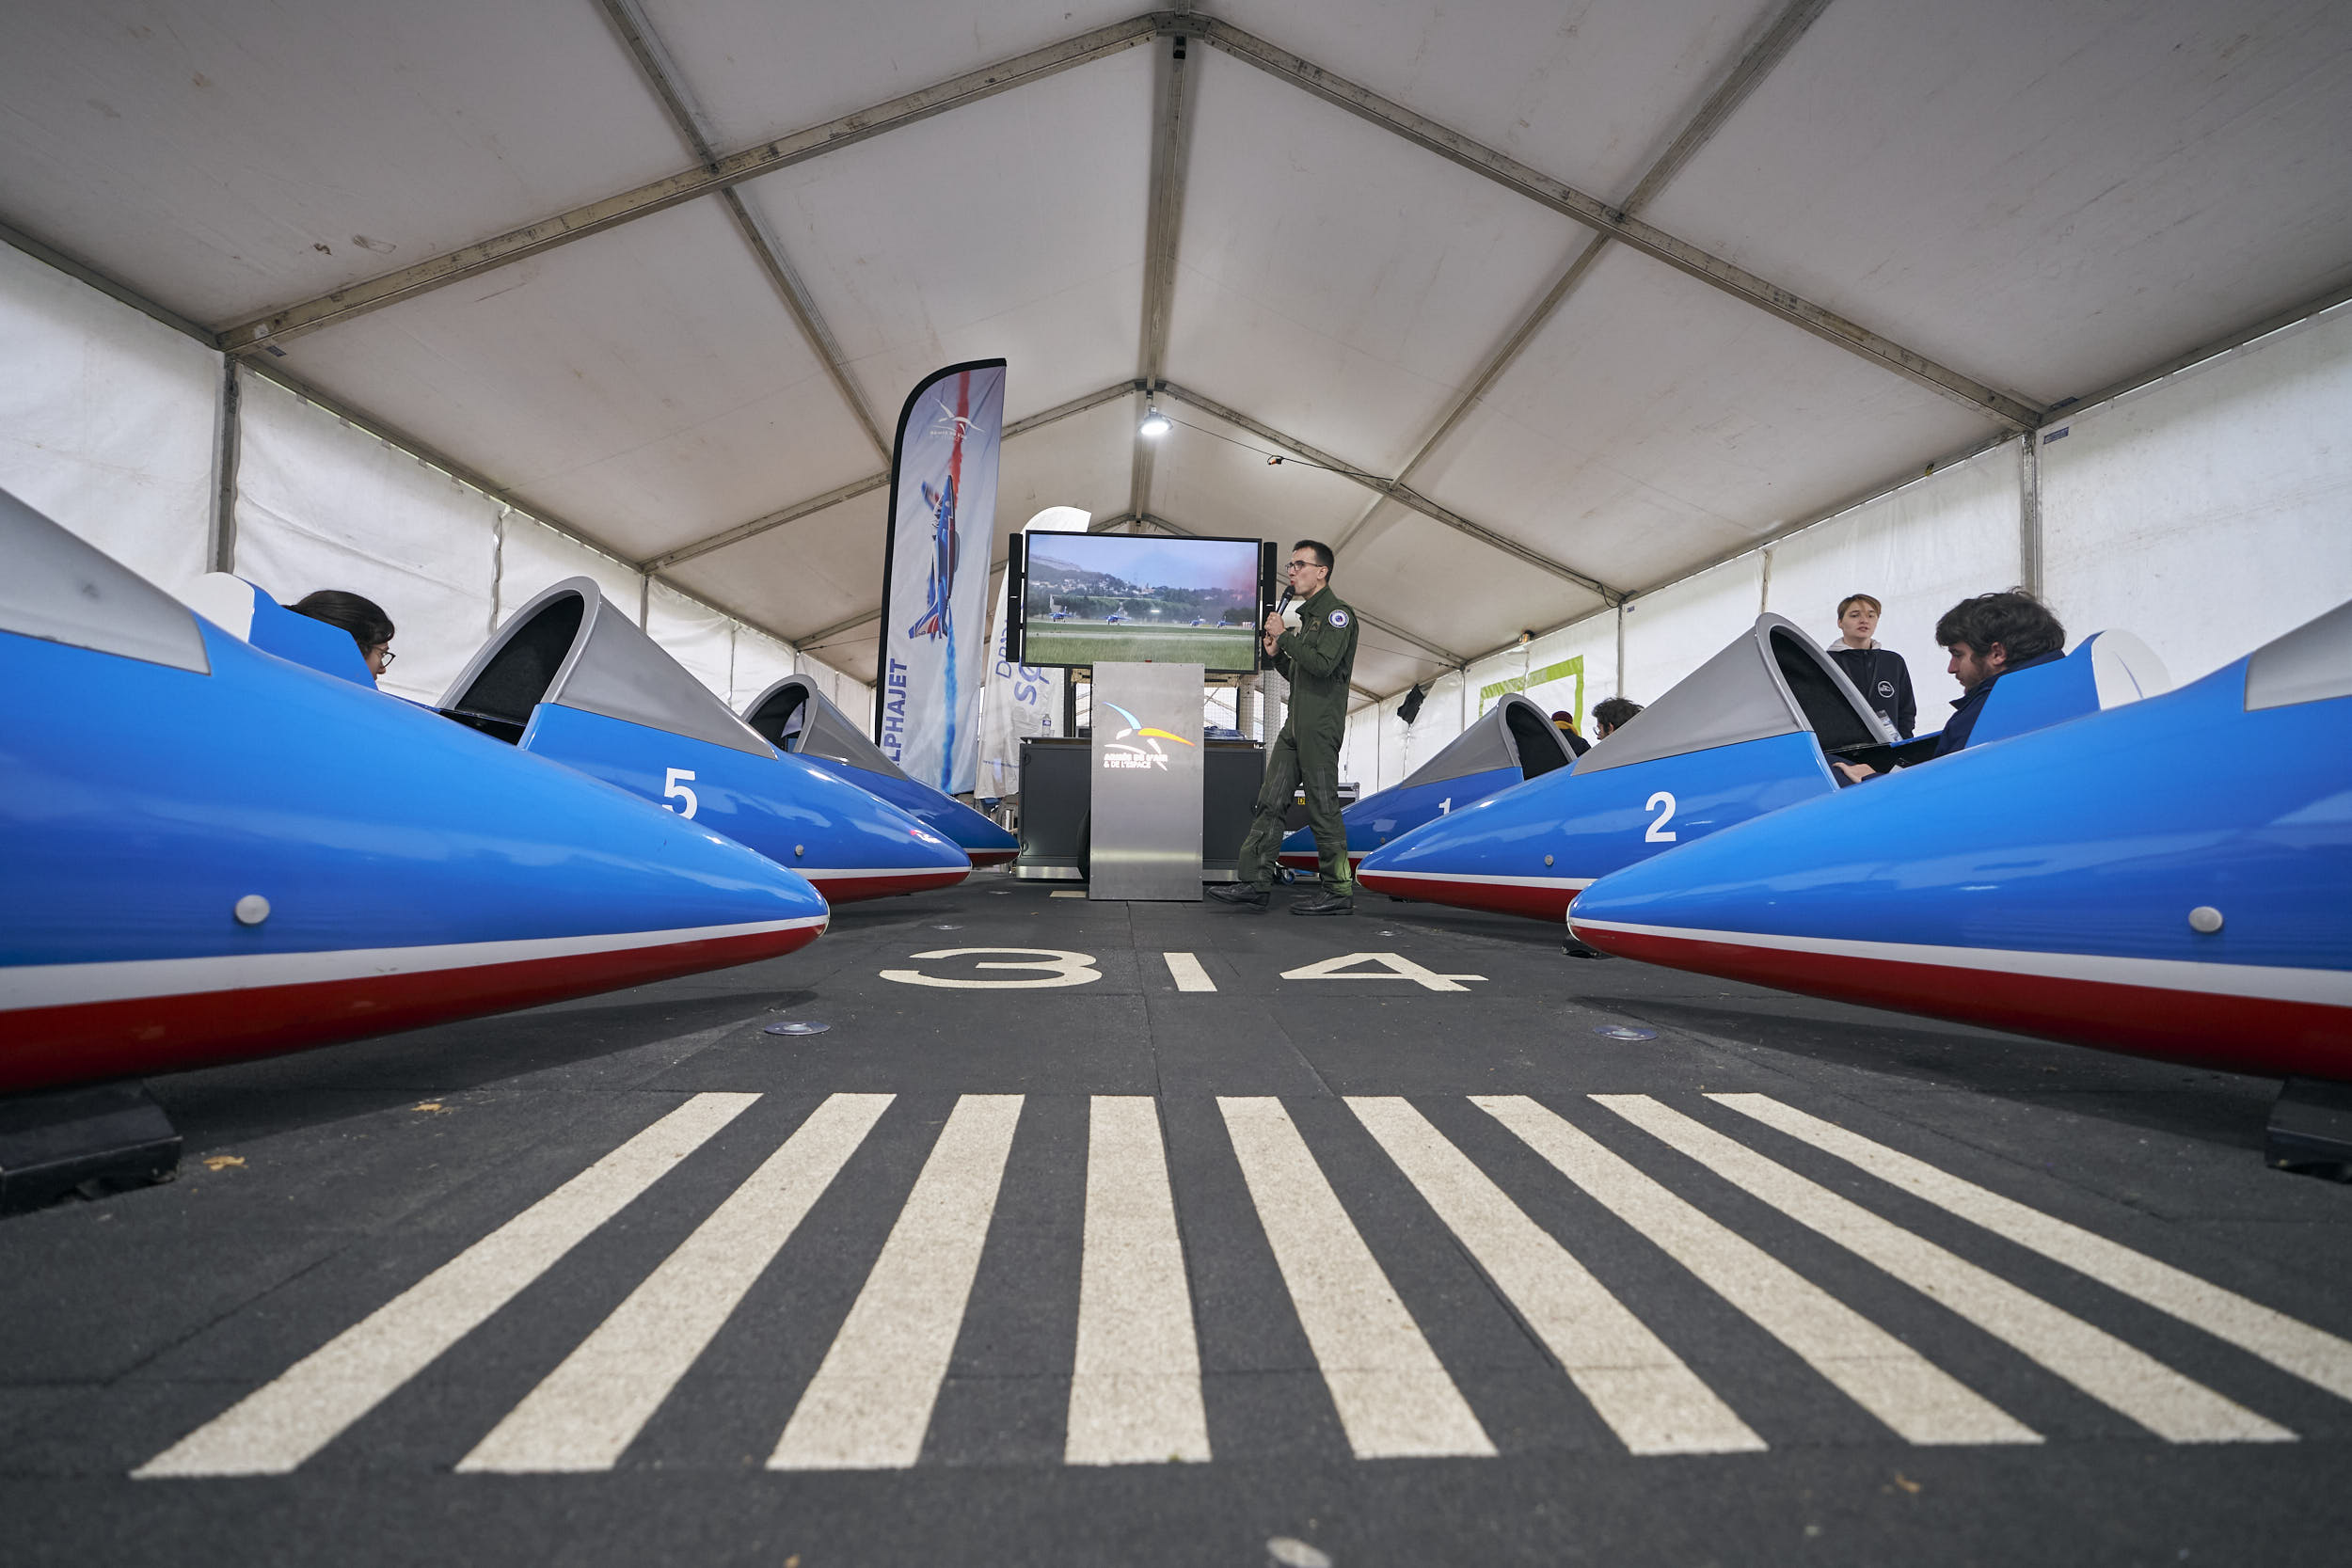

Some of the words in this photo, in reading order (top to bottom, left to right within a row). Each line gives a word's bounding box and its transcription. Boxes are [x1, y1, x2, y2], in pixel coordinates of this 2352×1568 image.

[882, 657, 908, 767] LPHAJET
[662, 768, 697, 819] 5
[1438, 797, 1452, 815] 1
[1645, 791, 1677, 843] 2
